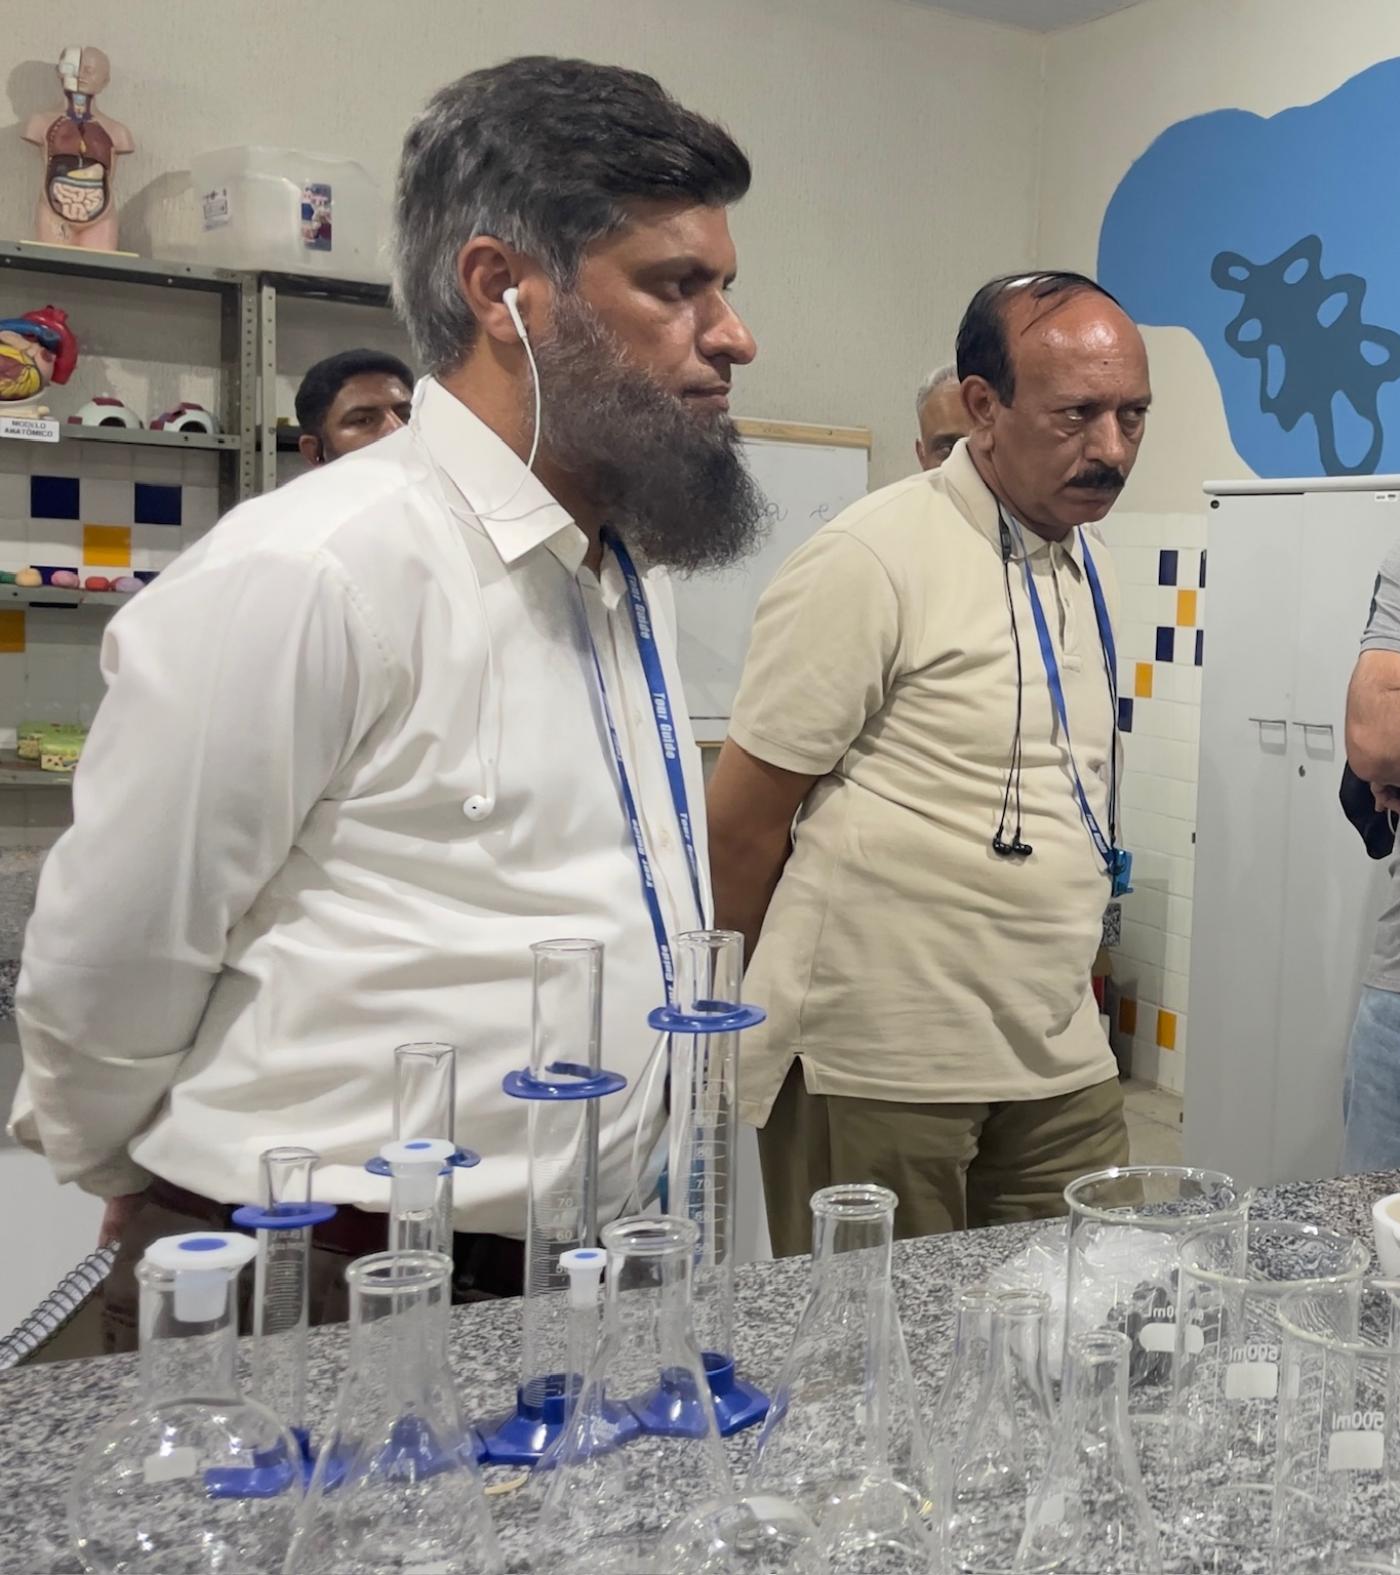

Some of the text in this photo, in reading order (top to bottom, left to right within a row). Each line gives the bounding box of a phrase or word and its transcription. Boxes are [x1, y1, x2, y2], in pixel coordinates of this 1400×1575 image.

[627, 574, 650, 640] Tour Guide
[653, 692, 676, 760] Tour Guide
[680, 812, 691, 839] Tour
[631, 818, 653, 888] Tour Guide
[661, 945, 674, 982] Guide
[559, 1198, 574, 1207] 70
